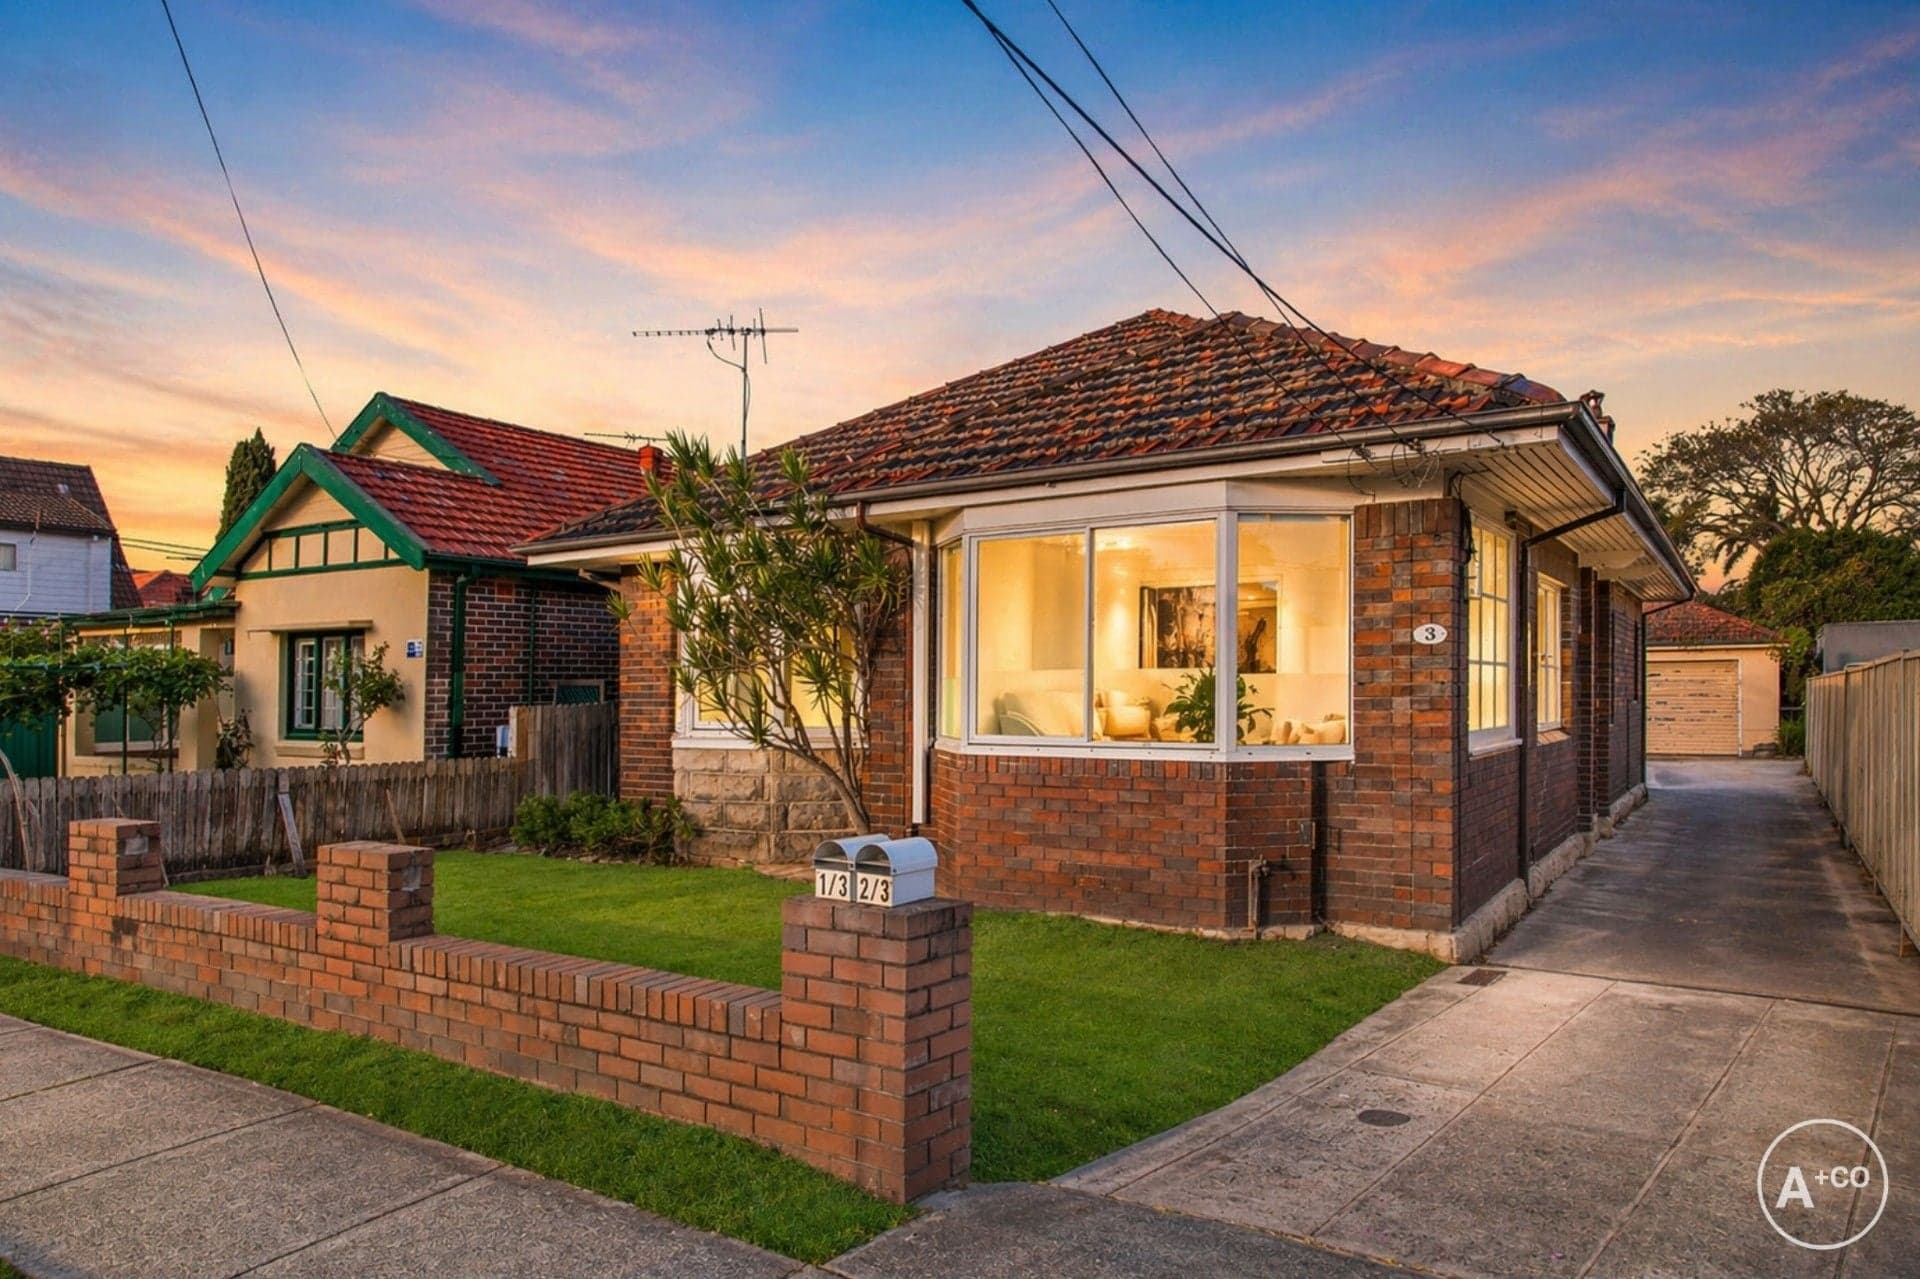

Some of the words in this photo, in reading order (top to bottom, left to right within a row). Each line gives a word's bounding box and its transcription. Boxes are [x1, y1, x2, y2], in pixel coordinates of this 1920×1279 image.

[1425, 626, 1436, 641] 3
[819, 872, 848, 897] 1/3
[860, 877, 889, 903] 2/3
